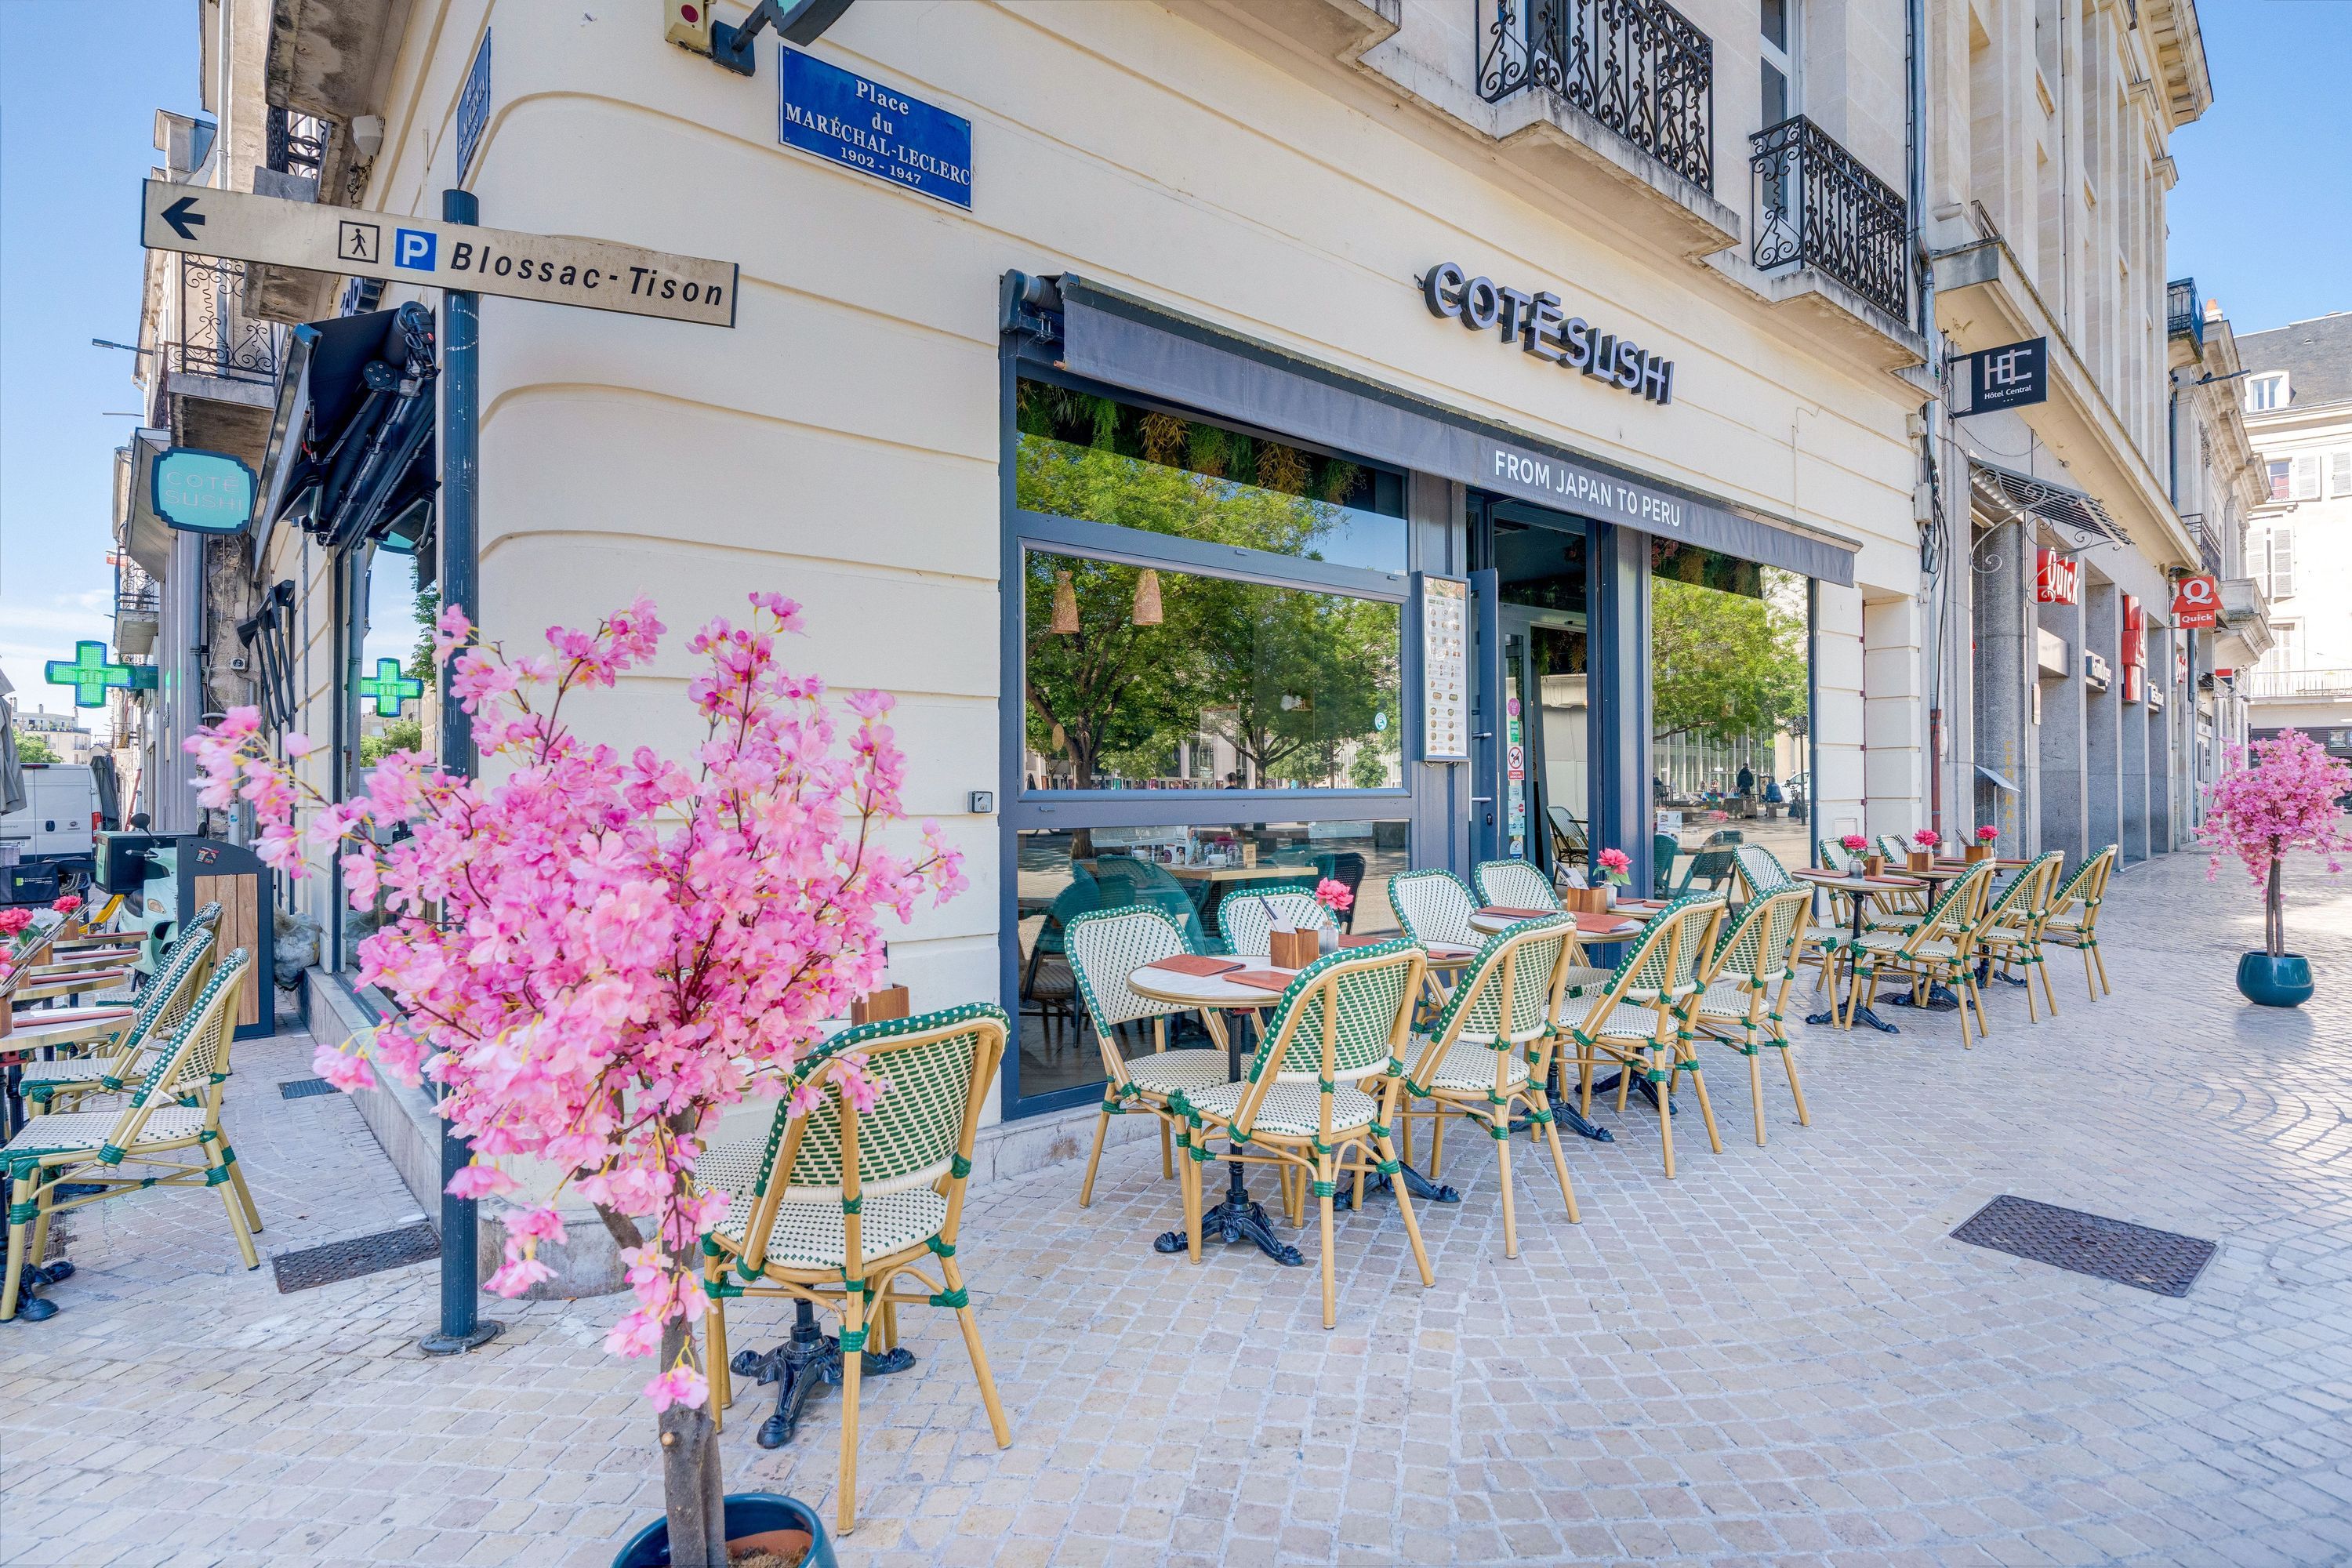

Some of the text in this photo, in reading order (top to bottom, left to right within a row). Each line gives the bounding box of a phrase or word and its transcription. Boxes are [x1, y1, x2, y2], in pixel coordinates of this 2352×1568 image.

[856, 79, 909, 115] Place
[871, 112, 894, 136] du
[785, 102, 971, 186] MARÉCHAL-LECLERC
[841, 147, 875, 169] 1902
[890, 165, 922, 185] 1947
[450, 242, 723, 307] Blossac-Tison
[1984, 385, 2032, 400] Hôtel Central
[165, 489, 241, 511] SUSHI
[1495, 449, 1681, 528] FROM JAPAN TO PERU
[2047, 546, 2080, 605] Quick
[2183, 579, 2213, 605] Q
[2181, 613, 2213, 624] Quick
